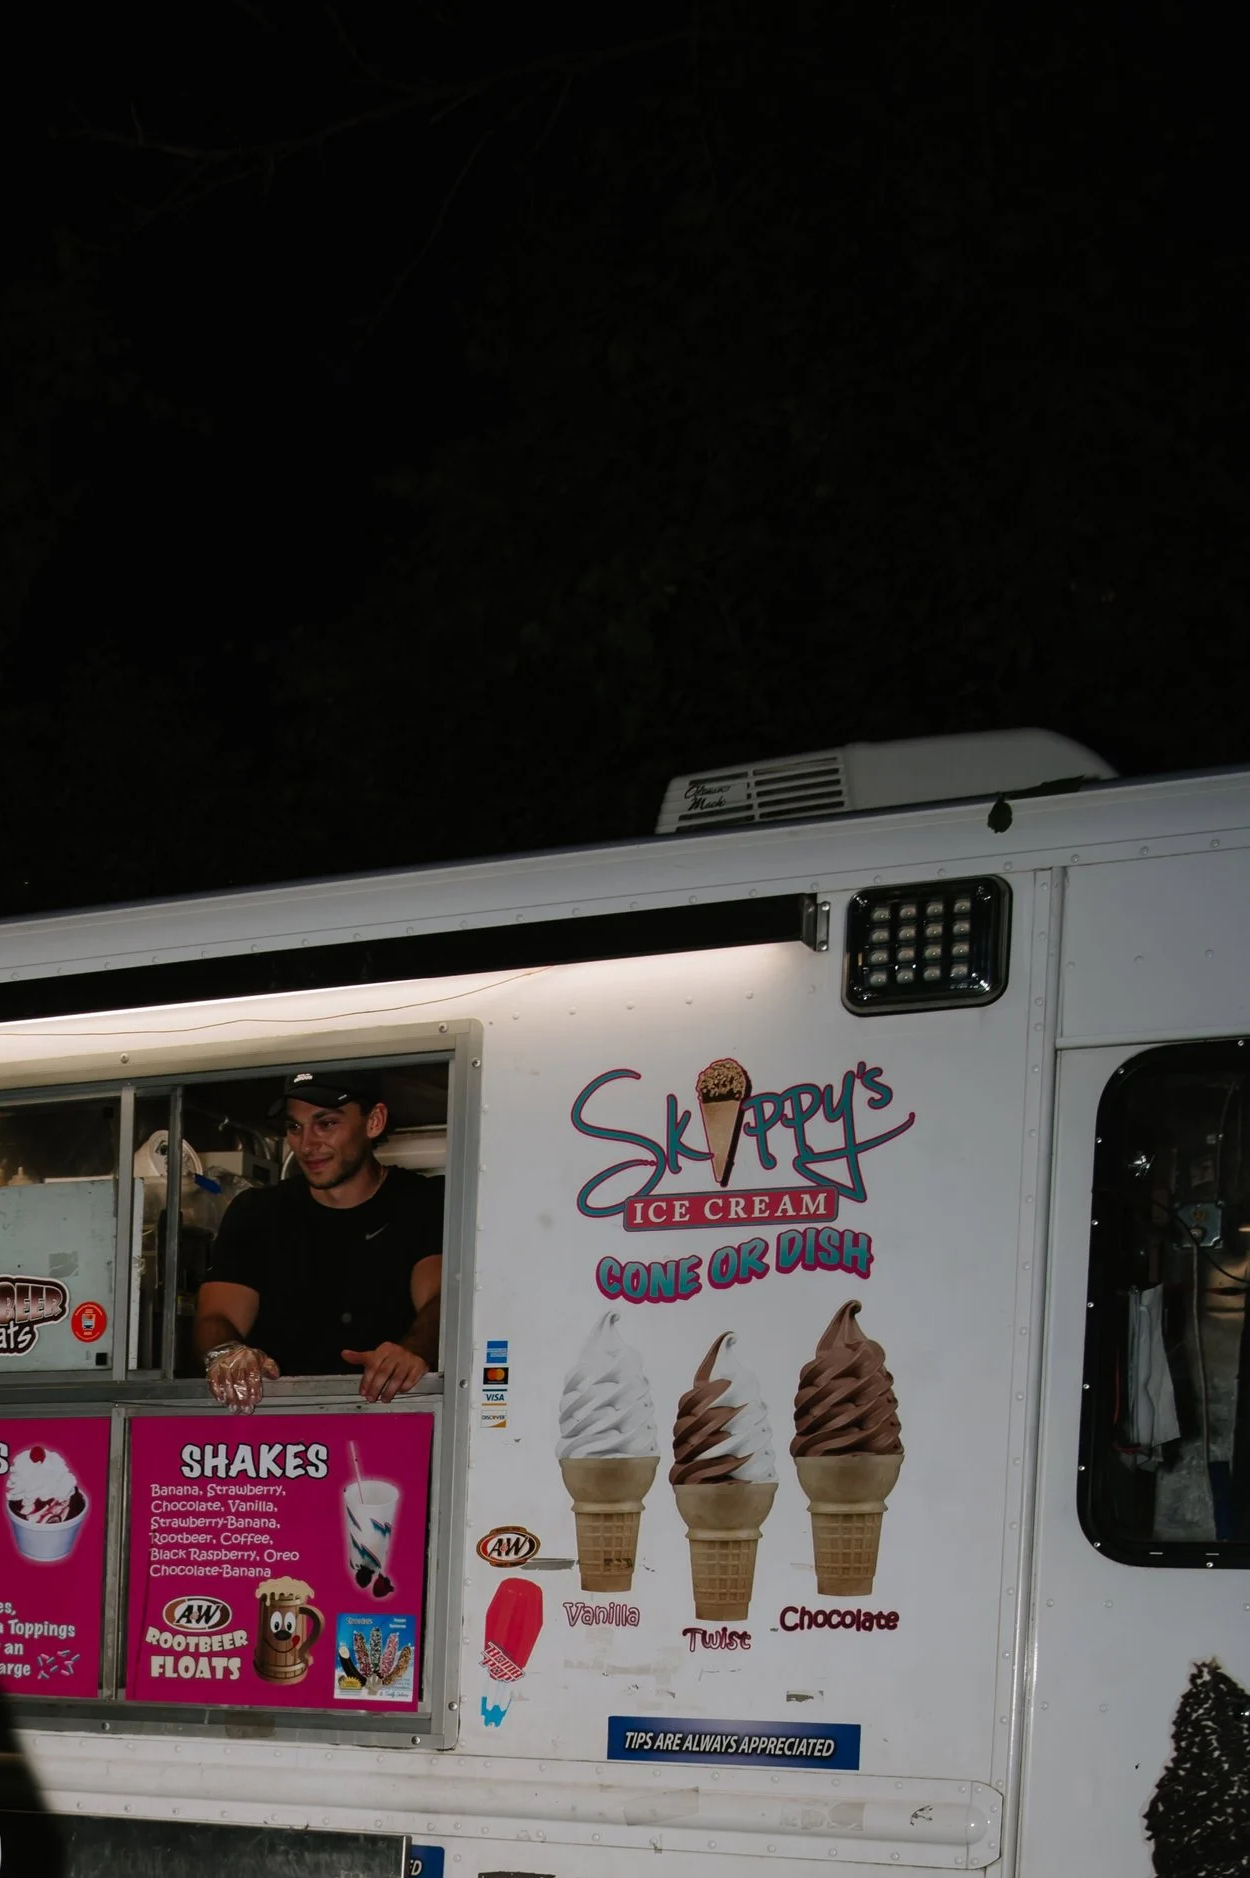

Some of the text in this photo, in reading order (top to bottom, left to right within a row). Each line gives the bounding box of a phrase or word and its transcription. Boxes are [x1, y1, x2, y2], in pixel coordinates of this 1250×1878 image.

[633, 1192, 828, 1224] ICE CREAM
[596, 1226, 874, 1304] CONE OR DISH
[485, 1393, 505, 1401] VISA
[180, 1442, 328, 1480] SHAKES
[150, 1483, 286, 1497] Banana, Strawberry,
[151, 1500, 278, 1513] Chocolate, Vanilla,
[150, 1516, 281, 1530] Strawberry-Banana,
[149, 1532, 273, 1545] Rootbeer, Coffee,
[150, 1548, 300, 1562] Black Raspberry, Oreo
[150, 1564, 271, 1578] Chocolate-Banana
[562, 1601, 641, 1628] Vanilla
[780, 1606, 900, 1633] Chocolate
[8, 1619, 76, 1640] Toppings
[145, 1626, 249, 1653] ROOTBEER
[682, 1626, 752, 1652] Twist
[4, 1643, 24, 1656] an
[150, 1655, 242, 1680] FLOATS
[624, 1731, 835, 1757] TIPS ARE ALWAYS APPRECIATED
